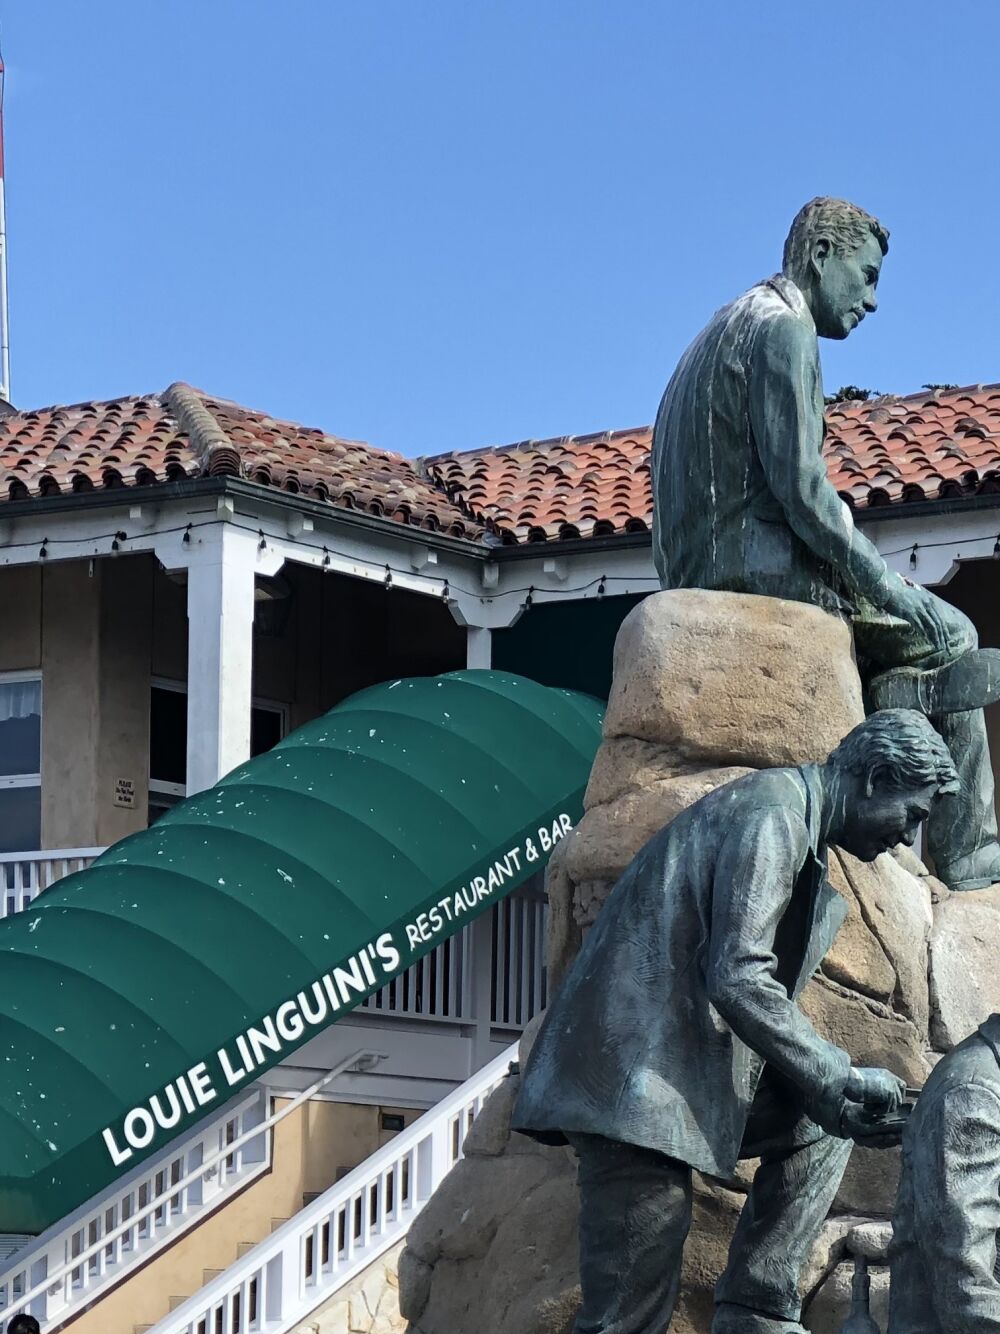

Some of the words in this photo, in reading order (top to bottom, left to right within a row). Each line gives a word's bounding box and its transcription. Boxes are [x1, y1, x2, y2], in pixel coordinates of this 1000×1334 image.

[102, 1061, 217, 1167] LOUIE
[217, 933, 400, 1086] LINGUINI'S
[405, 847, 521, 951] RESTAURANT
[525, 838, 539, 862] &
[538, 813, 573, 852] BAR
